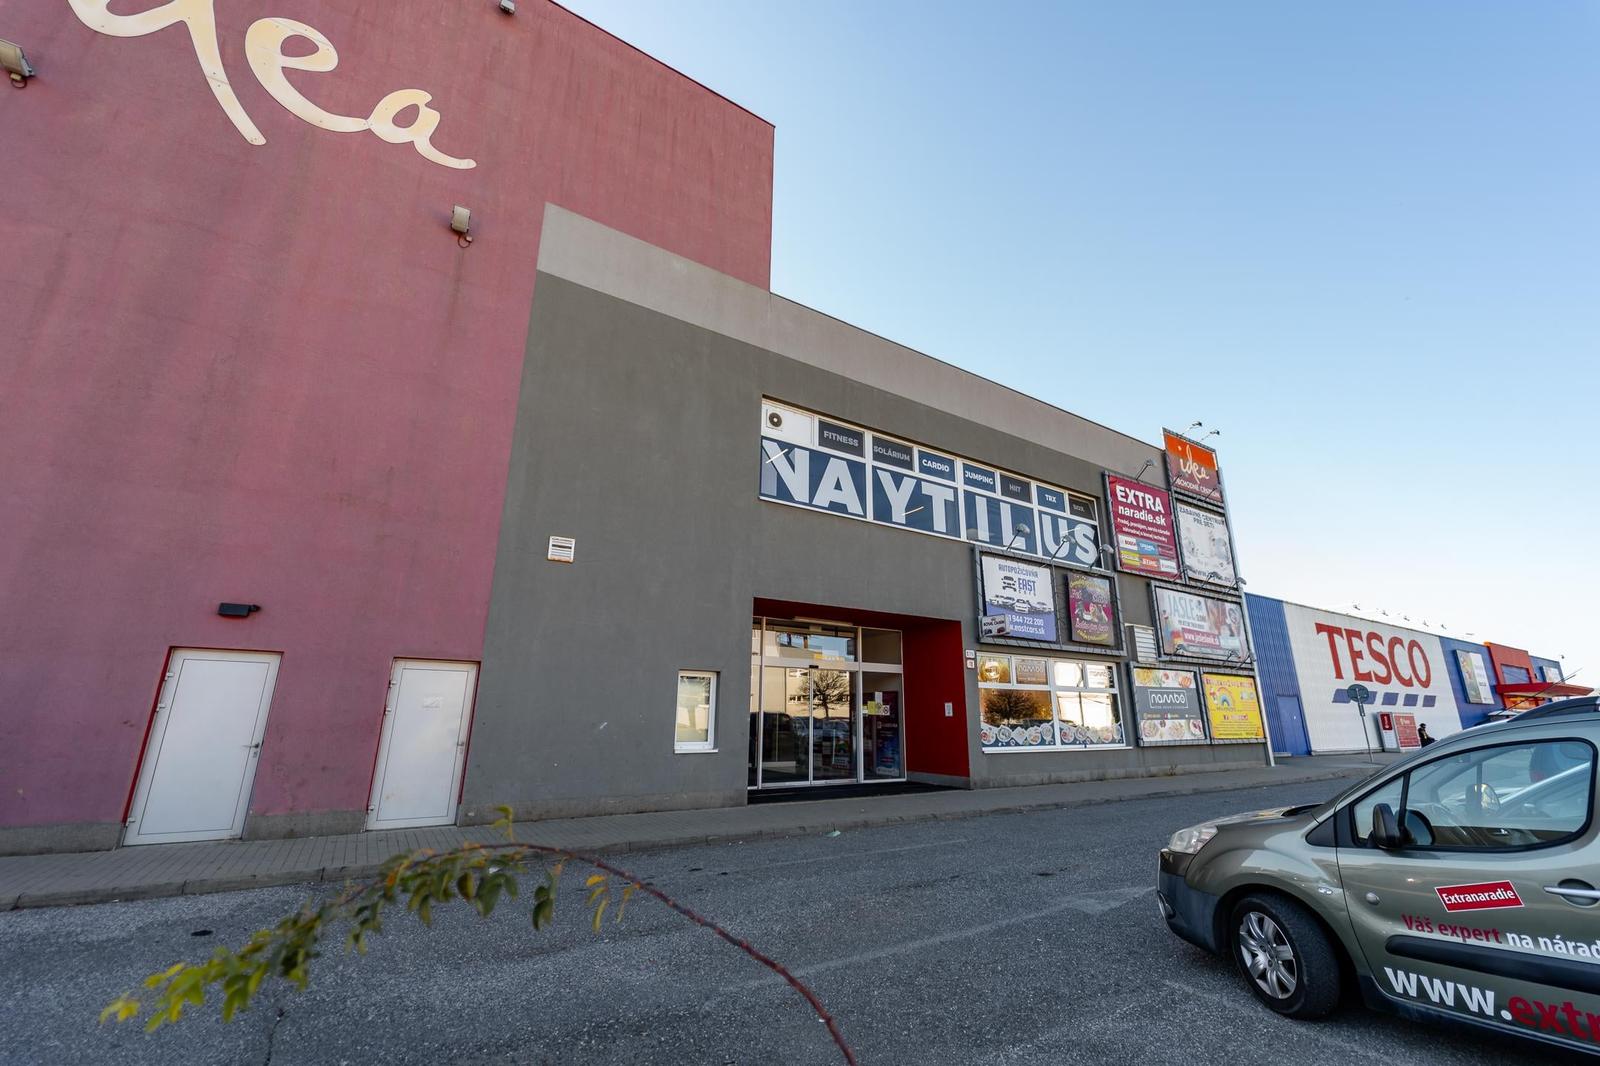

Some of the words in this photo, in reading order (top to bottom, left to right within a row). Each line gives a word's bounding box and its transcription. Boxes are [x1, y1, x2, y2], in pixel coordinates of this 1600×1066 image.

[823, 430, 859, 448] FITNESS
[873, 444, 911, 463] SOLÁRIUM
[922, 458, 951, 473] CARDIO
[1178, 444, 1210, 484] idea
[964, 470, 994, 485] JUMPING
[1009, 483, 1022, 493] HIIT
[1044, 494, 1057, 503] TRX
[1116, 484, 1165, 514] EXTRA
[1118, 505, 1167, 527] naradie.sk
[1017, 577, 1037, 593] EAST
[1012, 615, 1023, 623] 944
[1023, 616, 1034, 625] 722
[1314, 622, 1431, 689] TESCO
[1150, 693, 1186, 704] nambo
[1442, 888, 1516, 905] Extranaradie
[1401, 913, 1434, 934] Váš
[1437, 923, 1503, 944] expert
[1505, 932, 1534, 950] na
